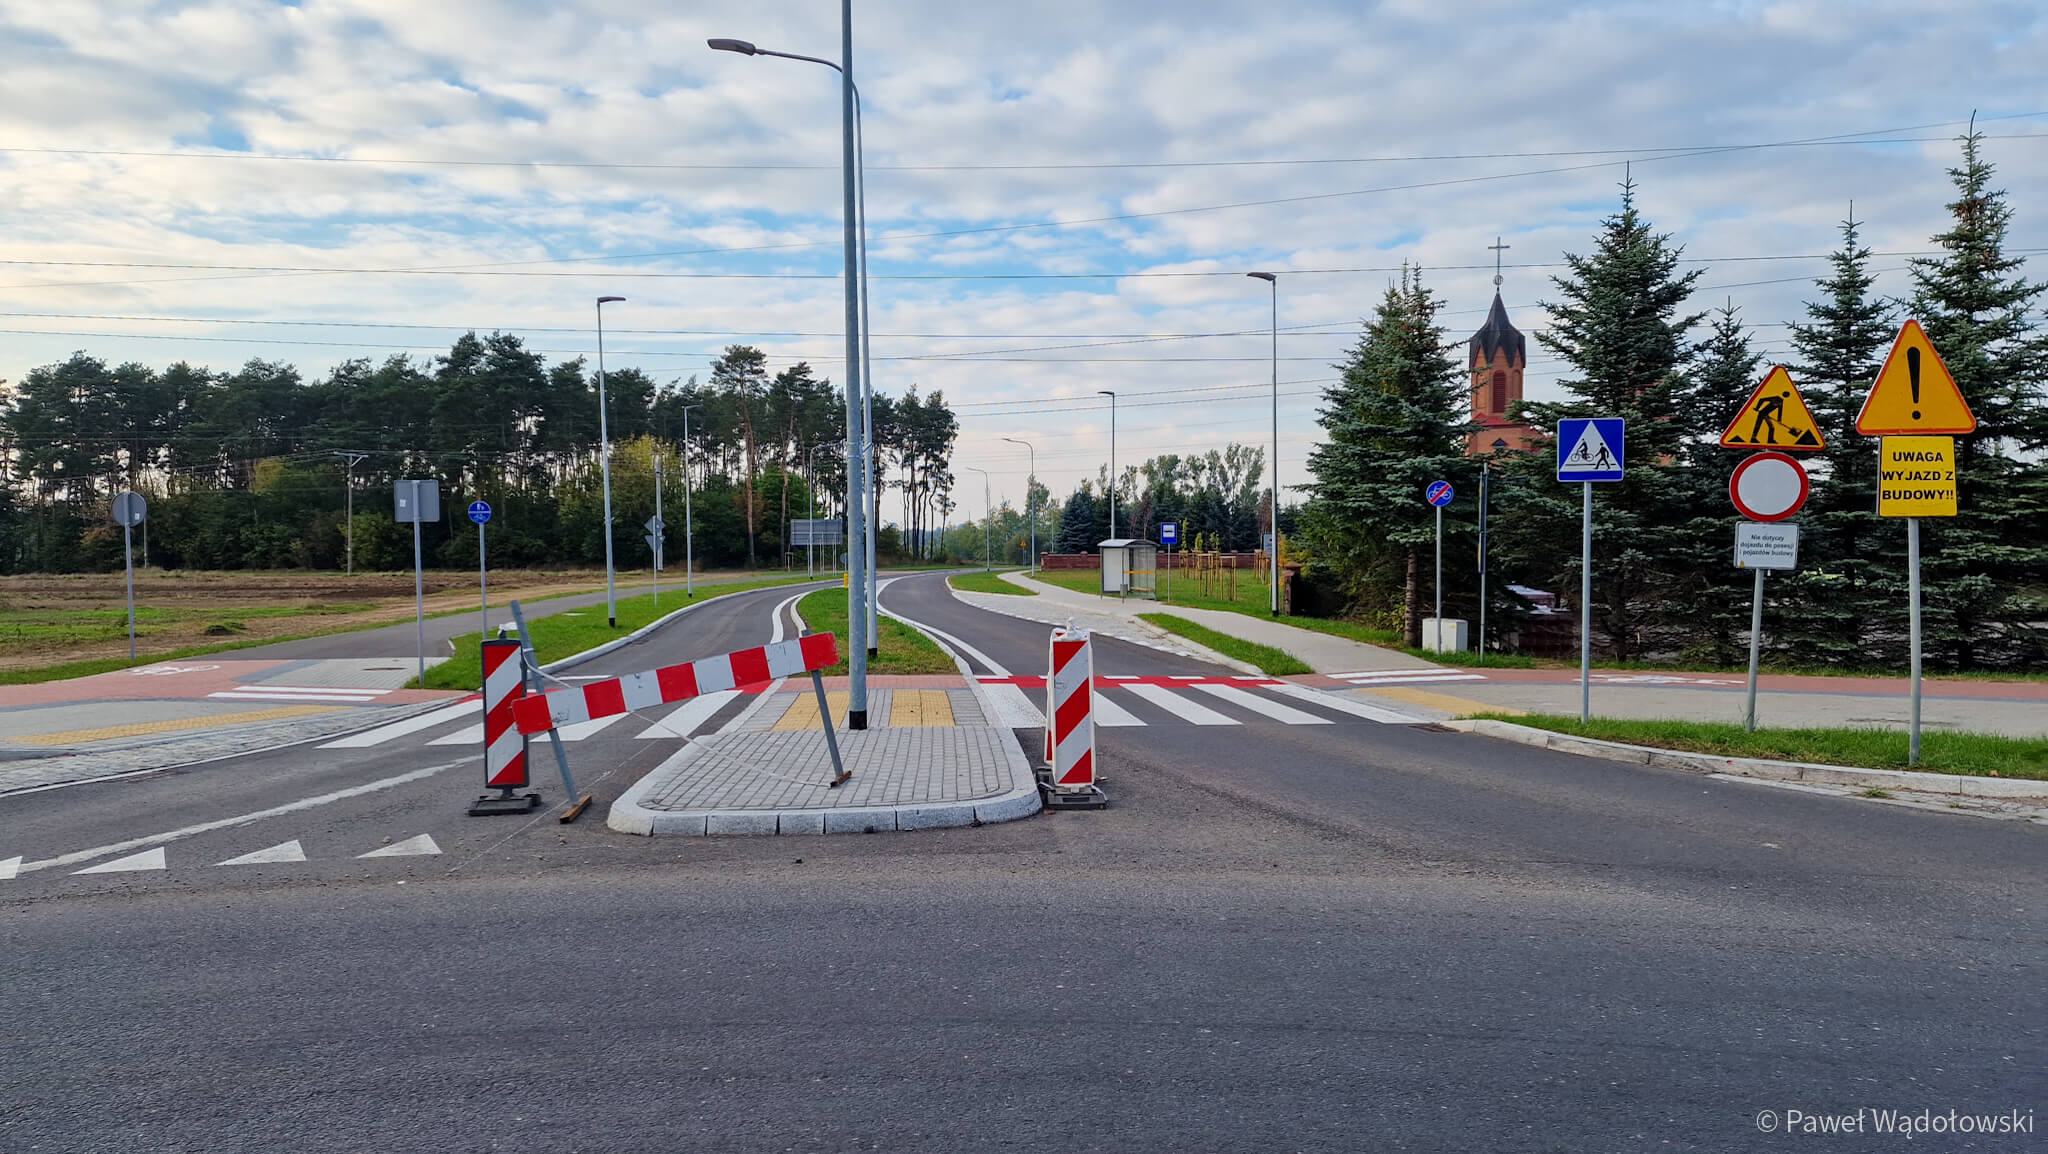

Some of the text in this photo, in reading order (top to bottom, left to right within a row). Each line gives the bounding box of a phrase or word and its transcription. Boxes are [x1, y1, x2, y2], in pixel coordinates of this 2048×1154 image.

[1892, 451, 1944, 462] UWAGA
[1881, 471, 1954, 481] WYJAZD Z
[1882, 489, 1954, 500] BUDOWY!!
[1762, 534, 1784, 542] dotyczy
